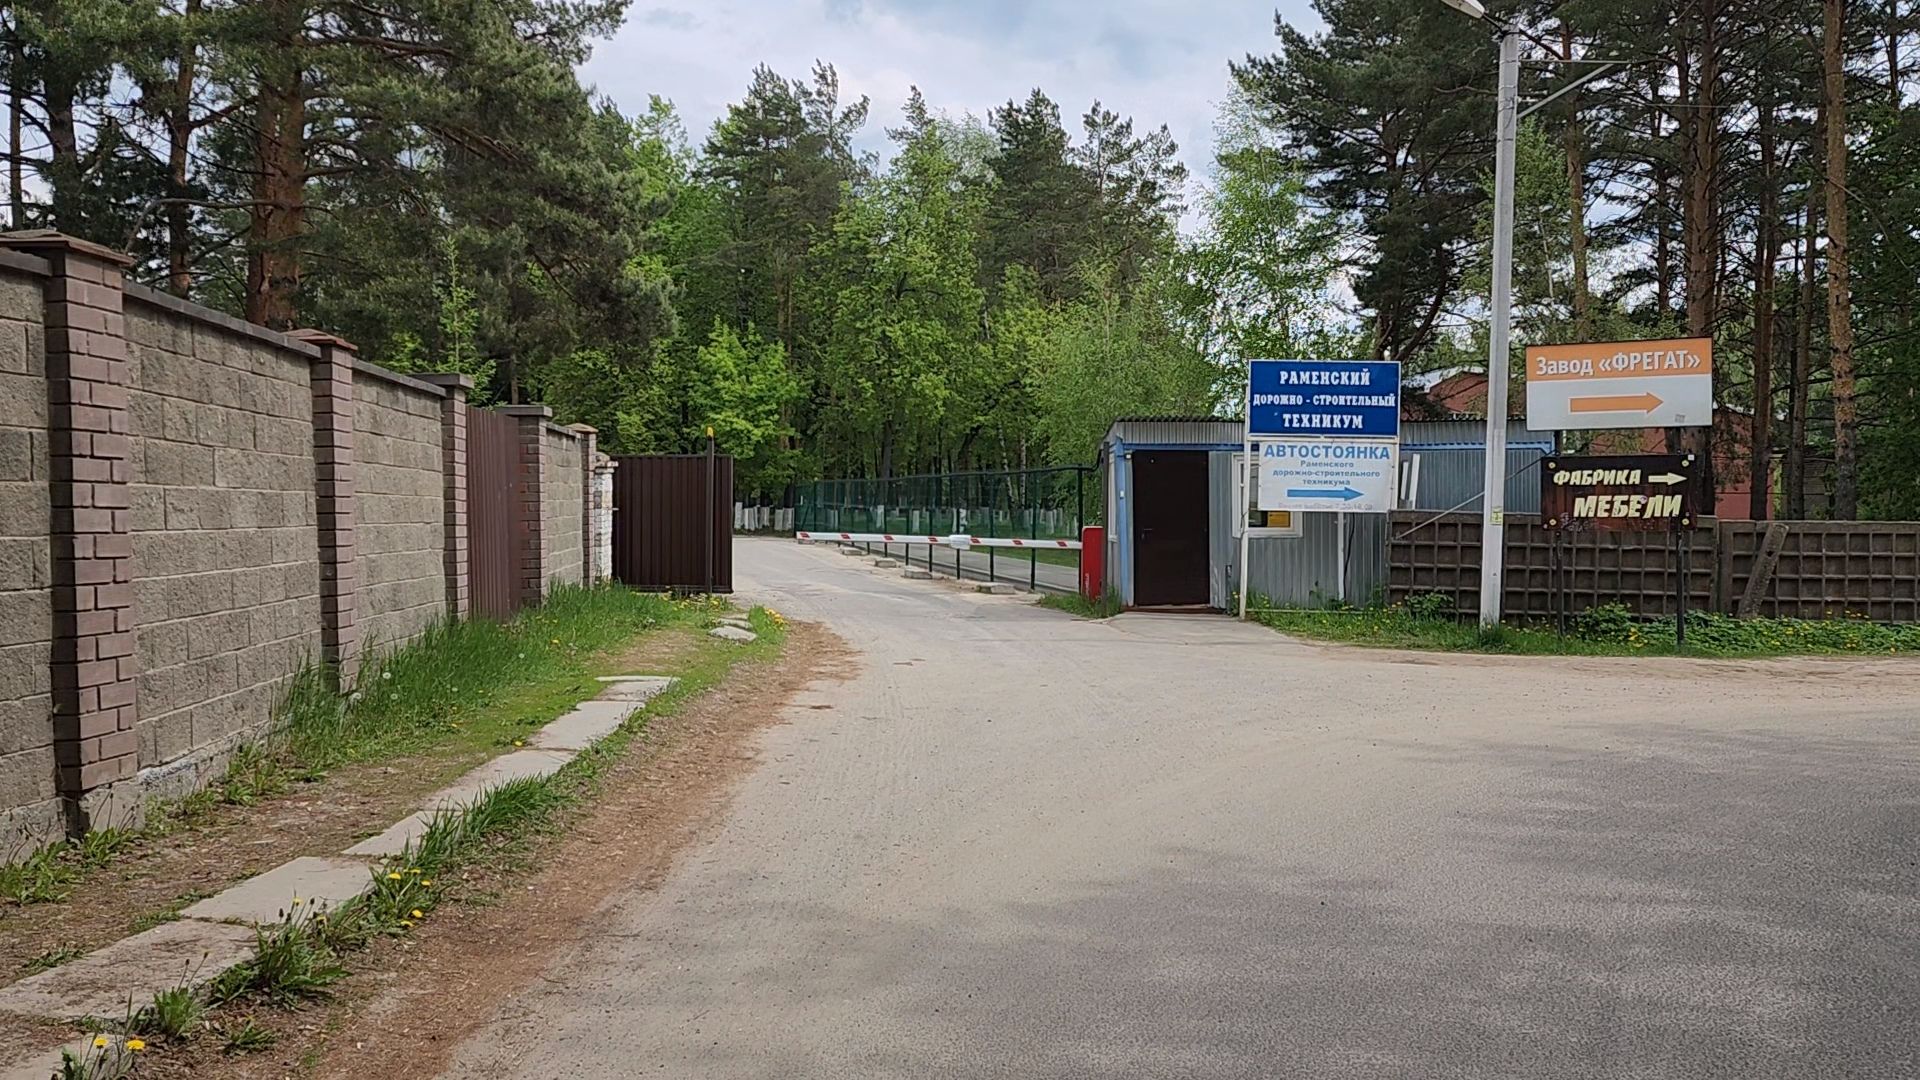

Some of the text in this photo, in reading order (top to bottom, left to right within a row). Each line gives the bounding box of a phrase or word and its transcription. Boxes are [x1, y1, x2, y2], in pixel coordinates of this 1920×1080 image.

[1536, 350, 1701, 376] Завод «ФРЕГАТ»
[1280, 368, 1370, 386] РАМЕНСКИЙ
[1253, 394, 1303, 406] ДОРОЖНО
[1313, 393, 1396, 407] СТРОИТЕЛЬНЫЙ
[1282, 414, 1363, 429] ТЕХНИКУМ
[1264, 444, 1390, 460] АВТОСТОЯНКА
[1300, 460, 1354, 469] Раменского
[1272, 469, 1381, 478] дорожно-строительного
[1553, 469, 1642, 486] ФАБРИКА
[1302, 478, 1351, 487] техникума
[1573, 494, 1682, 519] МЕБЕЛИ
